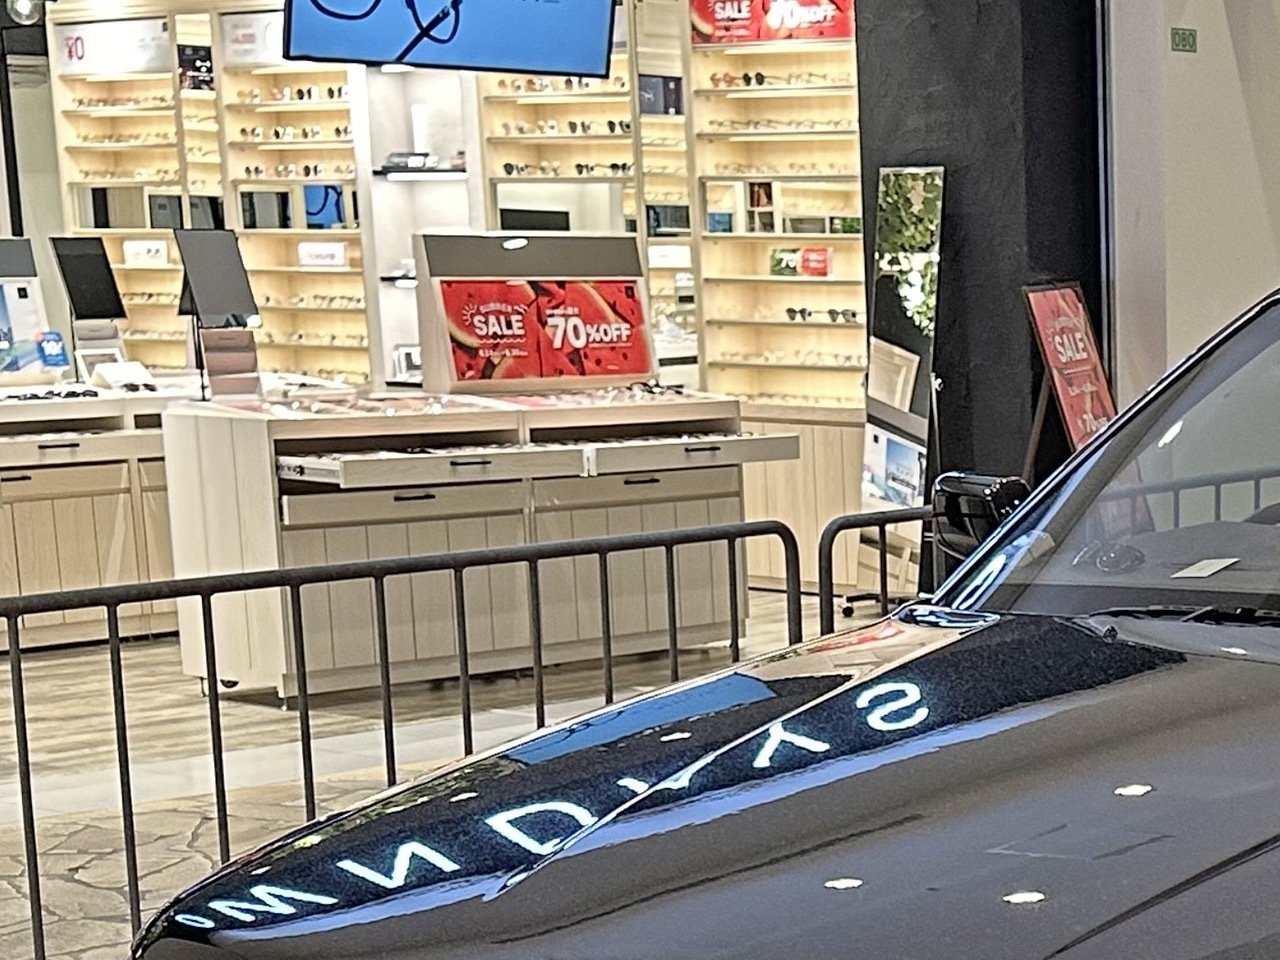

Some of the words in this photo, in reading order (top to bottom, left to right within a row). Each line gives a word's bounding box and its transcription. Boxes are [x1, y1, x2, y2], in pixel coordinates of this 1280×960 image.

[715, 1, 751, 19] SALE
[473, 314, 526, 336] SALE
[546, 316, 632, 349] 70%OFF
[1054, 332, 1088, 363] SALE
